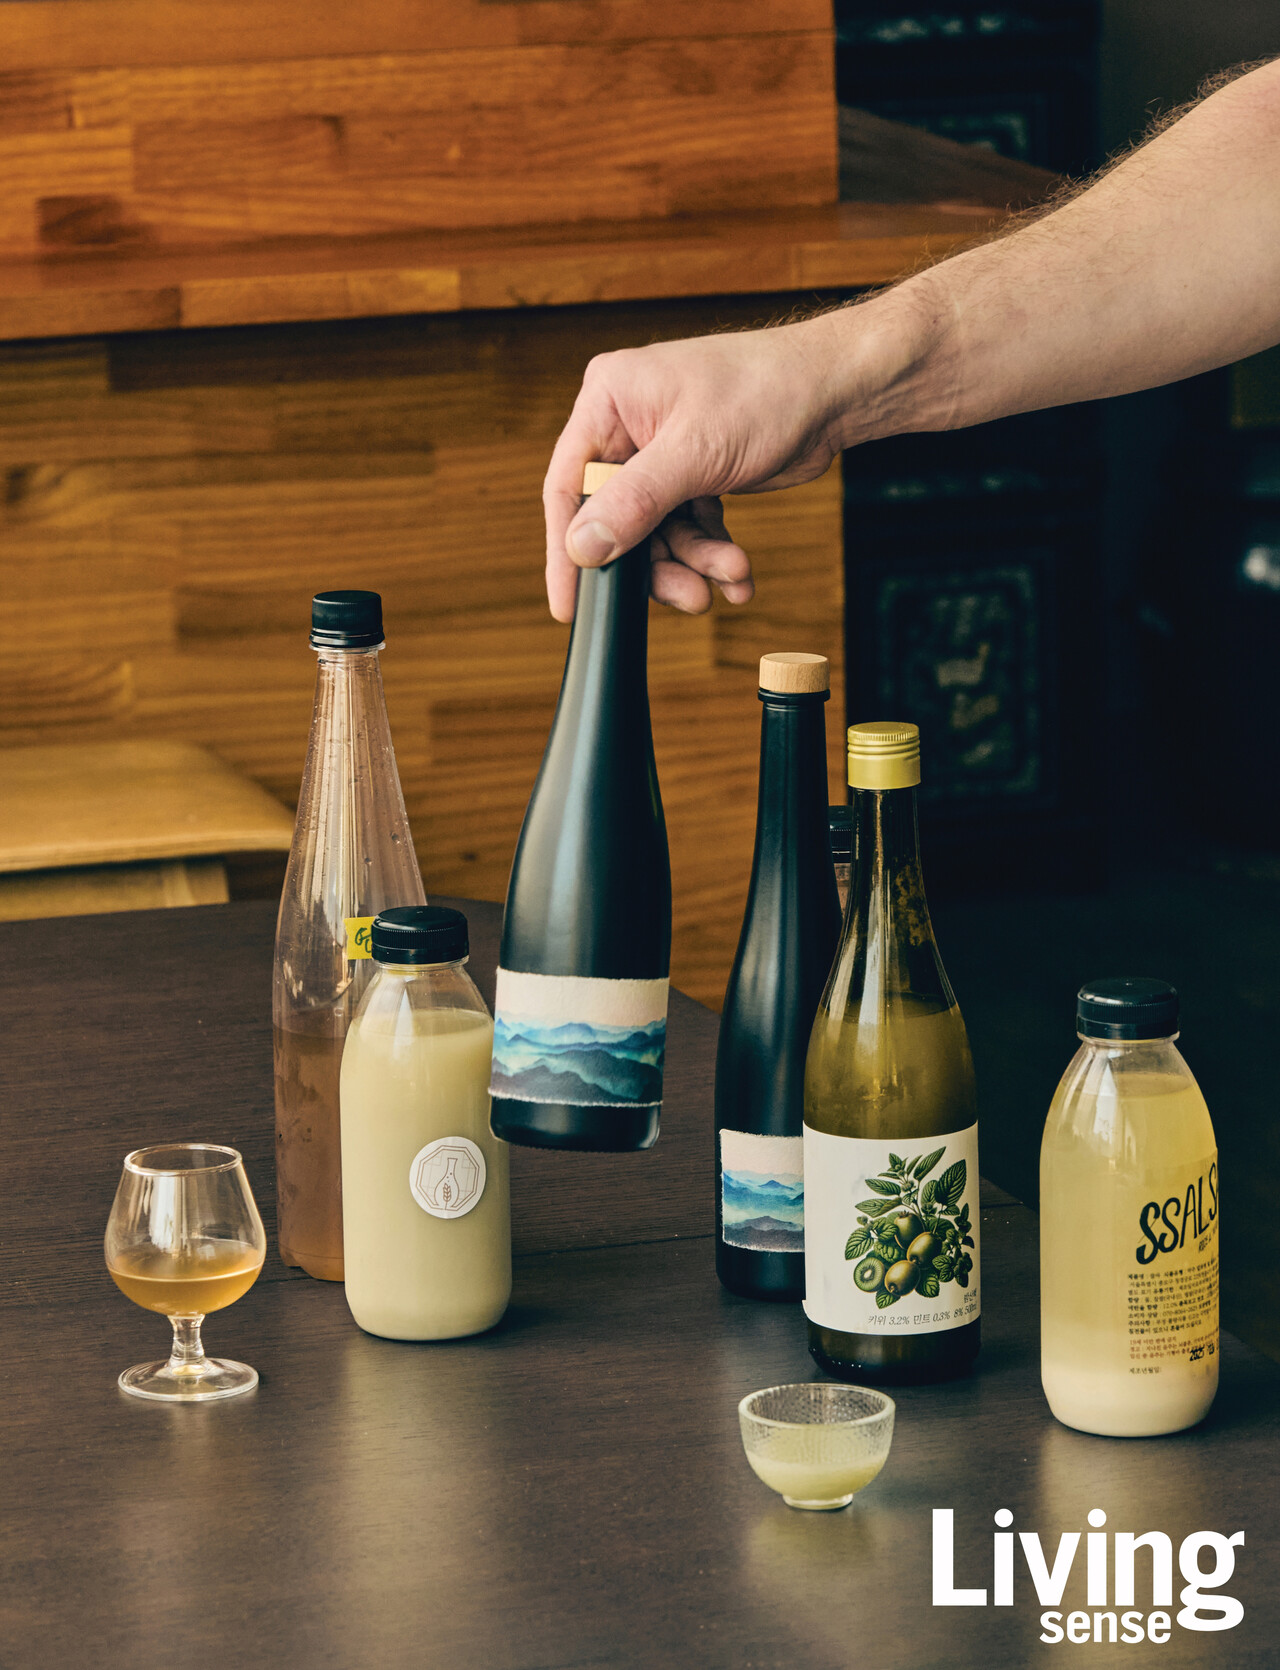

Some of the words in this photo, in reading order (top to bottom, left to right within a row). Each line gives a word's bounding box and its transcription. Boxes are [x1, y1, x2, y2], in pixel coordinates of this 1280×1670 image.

[1136, 1162, 1219, 1265] SSALS
[867, 1314, 887, 1326] 키위
[888, 1315, 911, 1326] 3.2%
[912, 1313, 931, 1325] 민트
[932, 1311, 951, 1323] 0.3%
[953, 1307, 964, 1319] 8%
